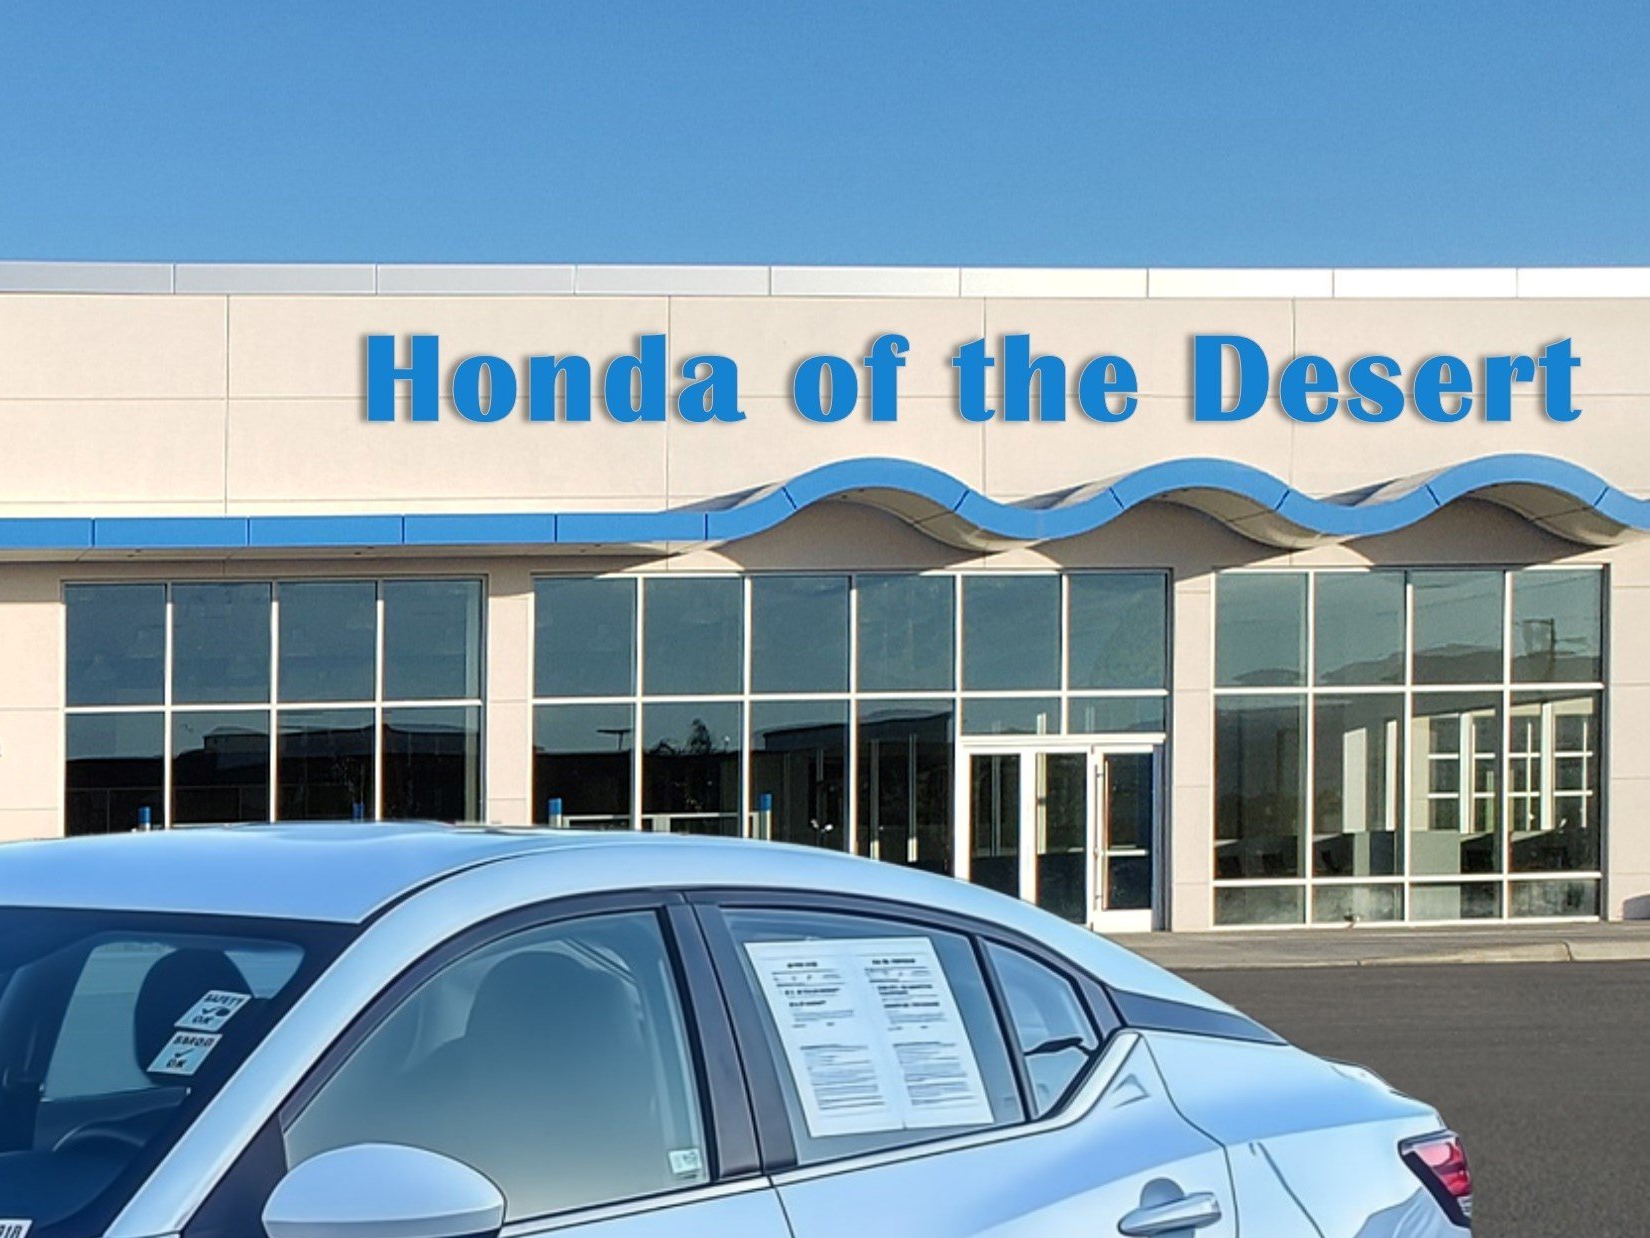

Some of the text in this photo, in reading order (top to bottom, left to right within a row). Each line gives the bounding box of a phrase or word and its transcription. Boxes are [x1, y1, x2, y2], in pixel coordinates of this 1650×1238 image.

[367, 334, 1582, 424] Honda of the Desert
